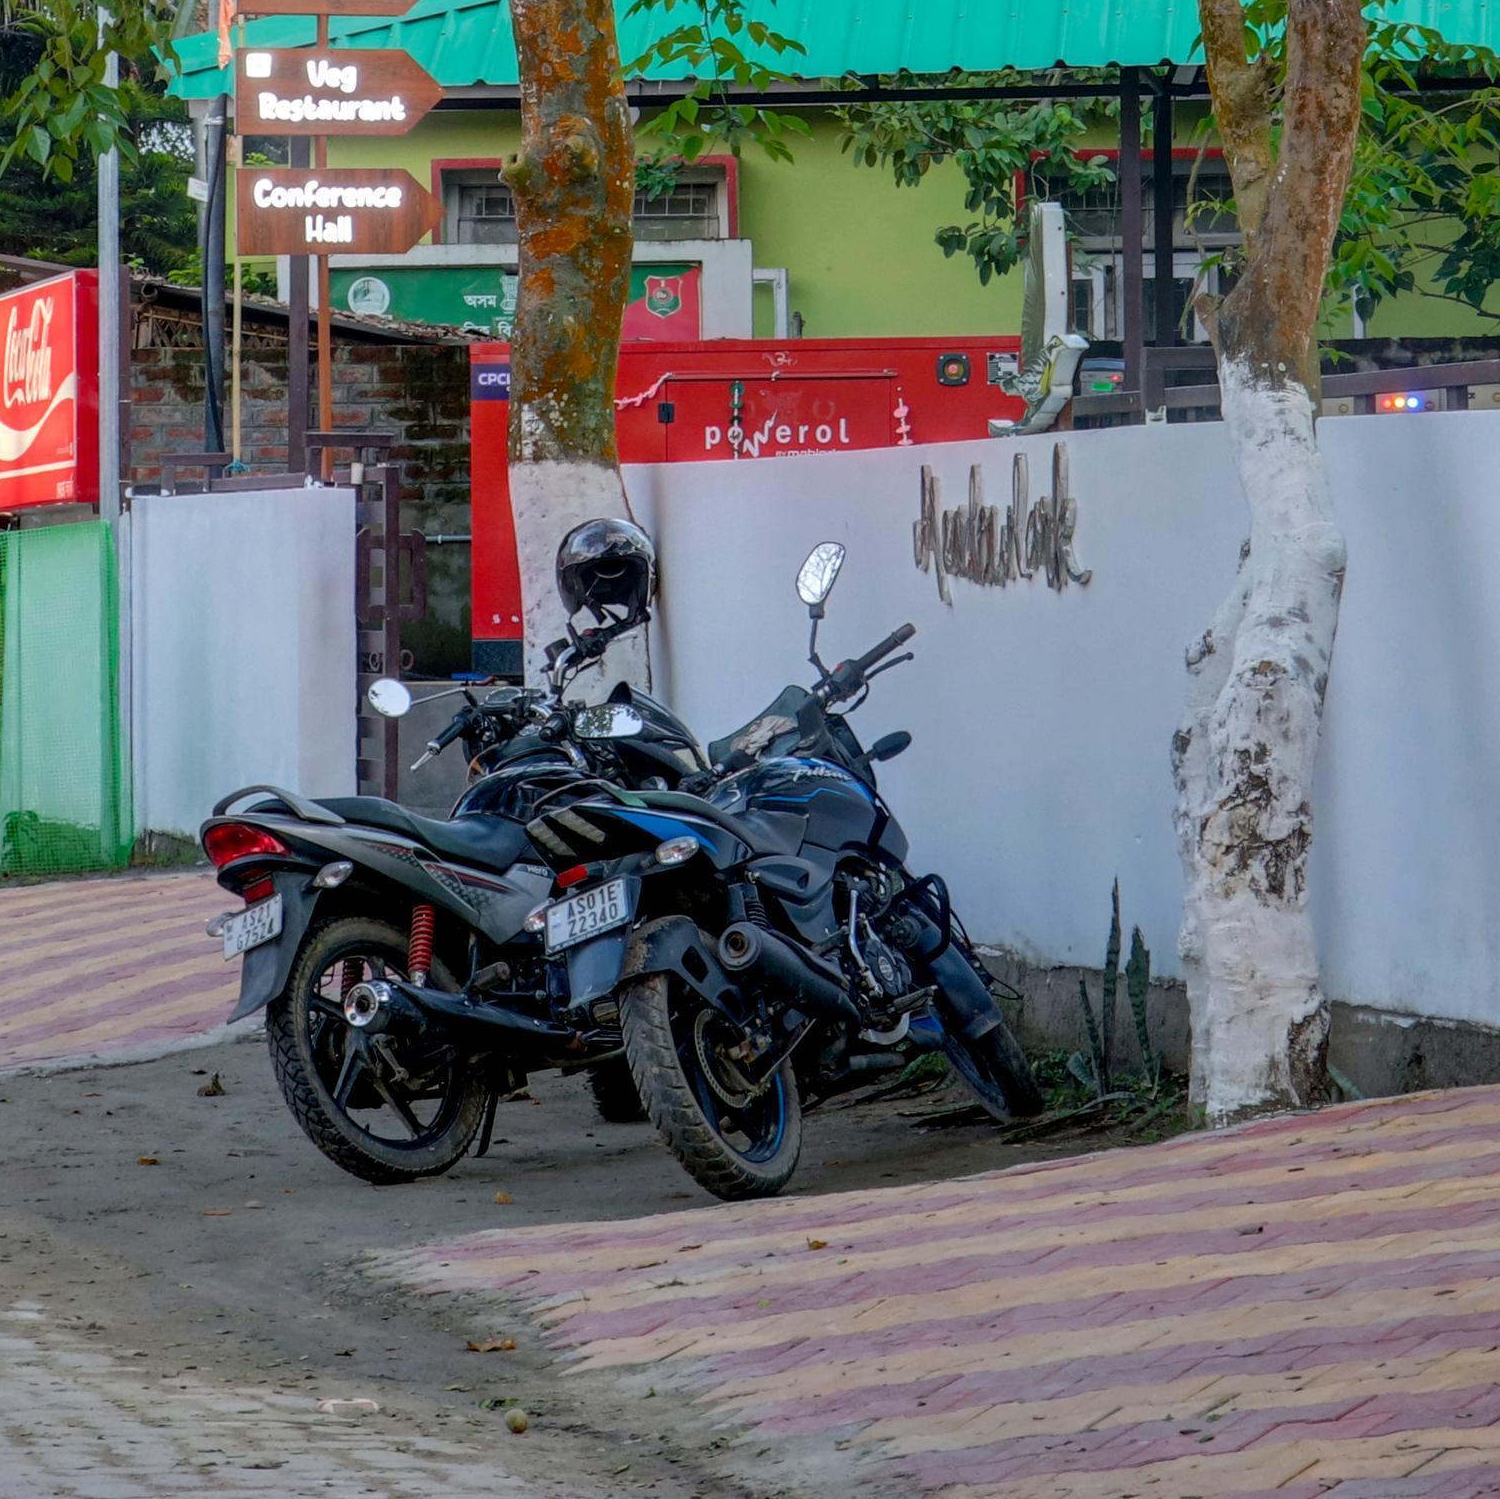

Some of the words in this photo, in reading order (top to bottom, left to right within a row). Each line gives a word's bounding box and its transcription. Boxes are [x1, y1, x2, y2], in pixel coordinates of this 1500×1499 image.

[306, 60, 358, 94] Veg
[258, 93, 406, 122] Restaurant
[252, 178, 402, 210] Conference
[304, 215, 352, 244] Hall
[567, 903, 619, 938] Z2340
